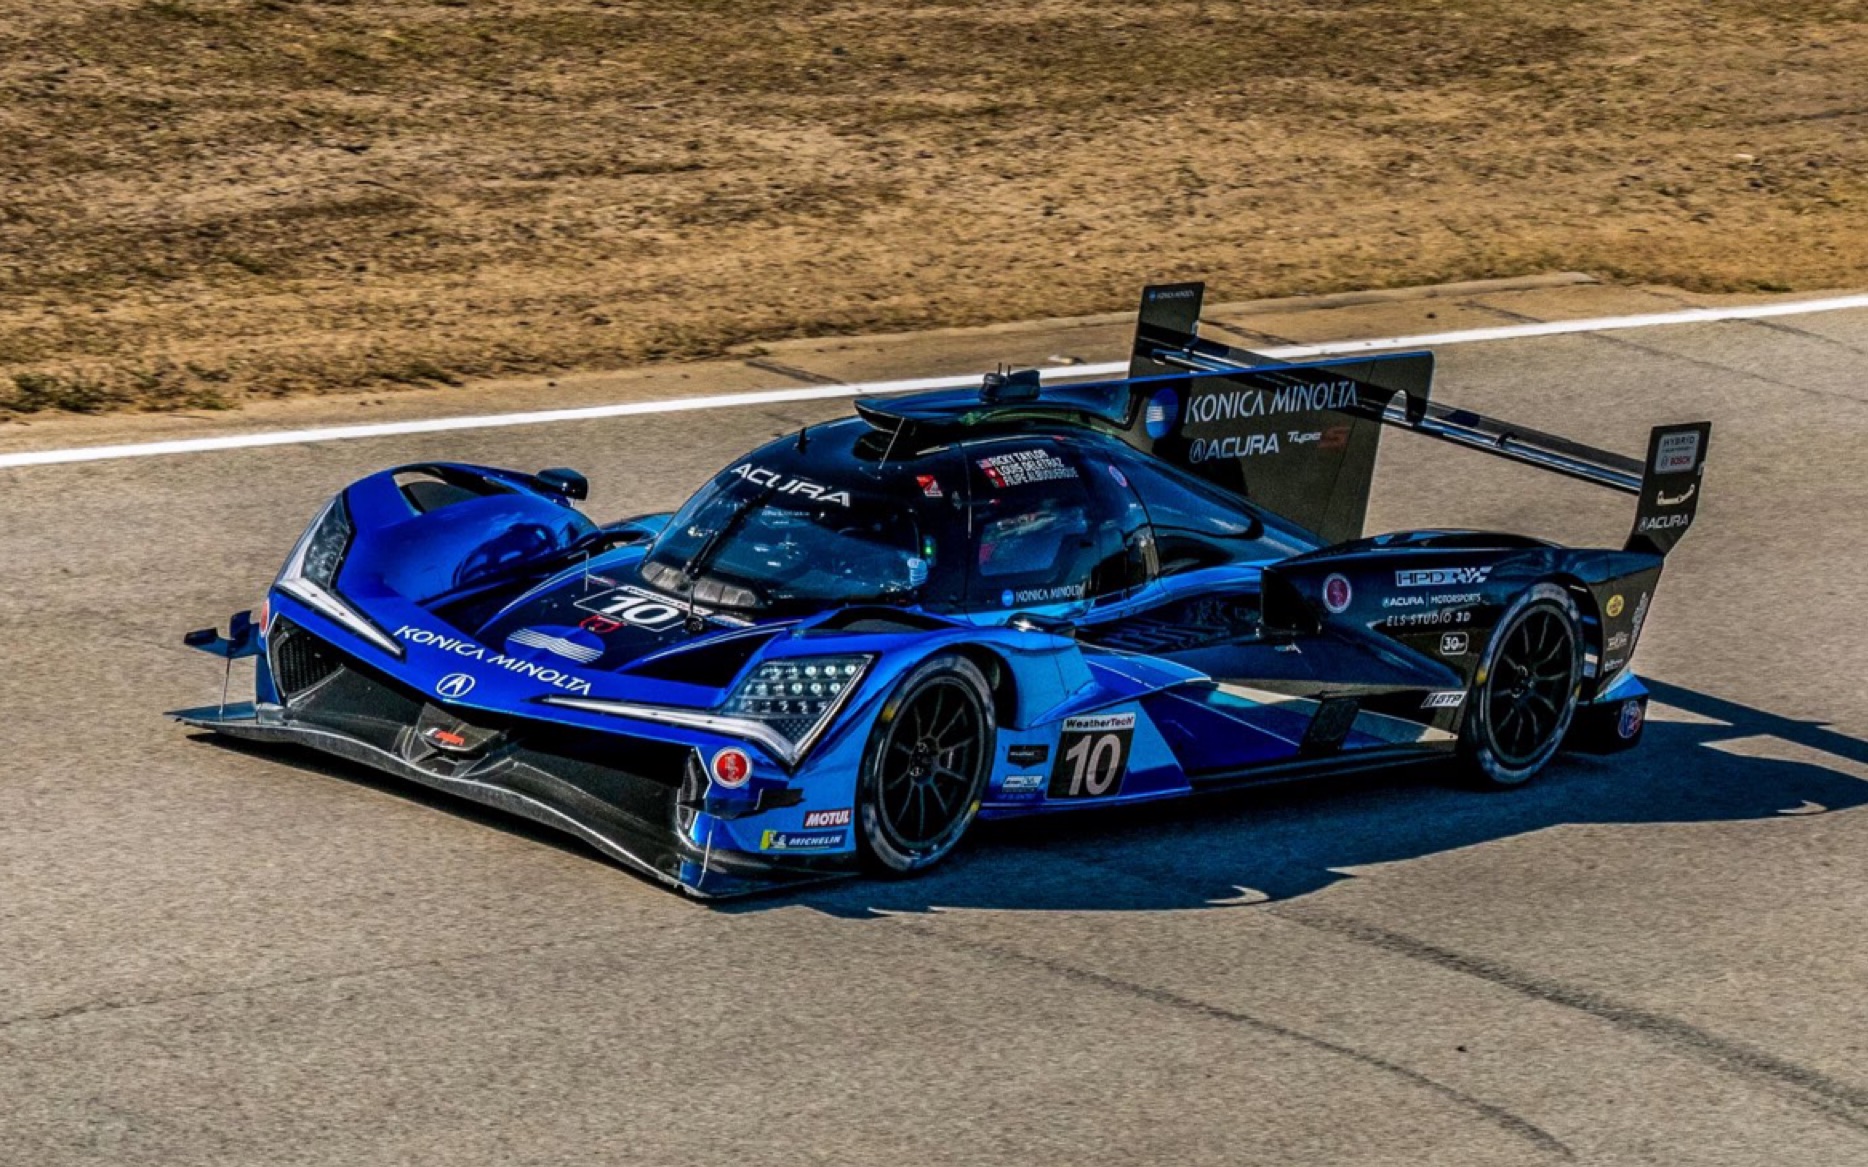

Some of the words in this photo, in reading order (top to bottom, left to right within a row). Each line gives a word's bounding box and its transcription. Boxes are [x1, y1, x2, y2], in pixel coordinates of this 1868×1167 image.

[1184, 390, 1265, 424] KONICA
[1269, 381, 1358, 415] MINOLTA
[1205, 433, 1280, 461] ACURA
[730, 463, 850, 507] ACURA
[1646, 514, 1689, 530] ACURA
[602, 596, 679, 625] 10
[1390, 596, 1424, 606] ACURA
[1430, 592, 1481, 604] MOTORSPORTS
[1386, 615, 1406, 627] ELS
[1409, 611, 1451, 626] STUDIO
[393, 625, 485, 660] KONICA
[486, 654, 592, 695] MINOLTA
[1066, 733, 1121, 796] 10
[805, 810, 850, 827] MOTUL
[788, 834, 843, 846] MICHELIN
